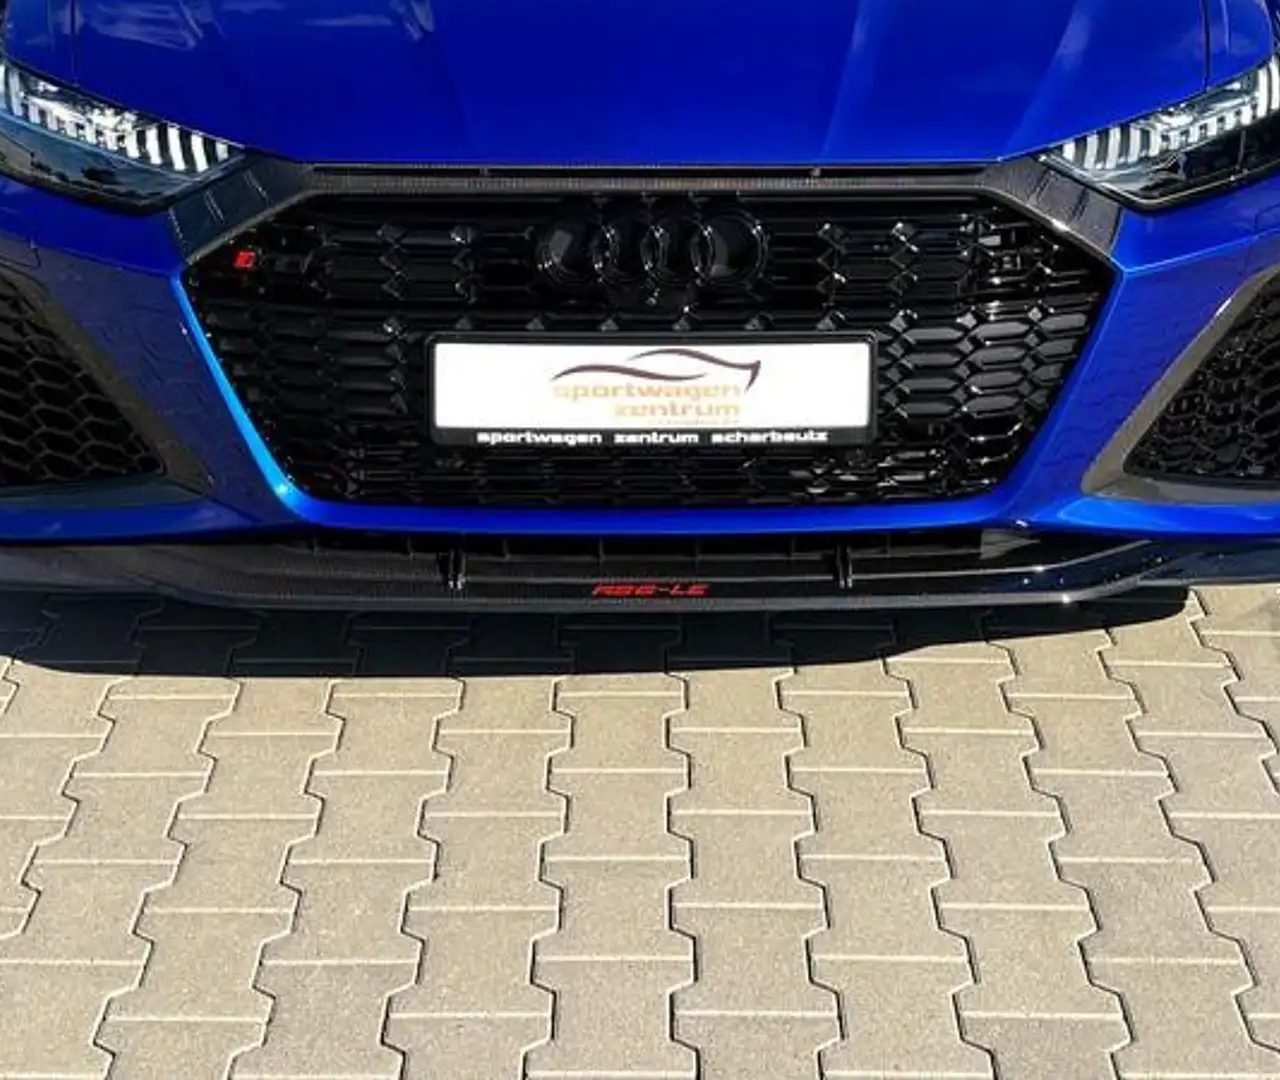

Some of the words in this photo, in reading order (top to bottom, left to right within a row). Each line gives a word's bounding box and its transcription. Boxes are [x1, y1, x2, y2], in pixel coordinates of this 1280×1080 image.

[552, 383, 741, 401] sportwagen
[613, 400, 741, 416] zentrum
[477, 430, 603, 446] sportwagen
[613, 431, 699, 443] zentrum
[710, 429, 829, 443] scharbeutz
